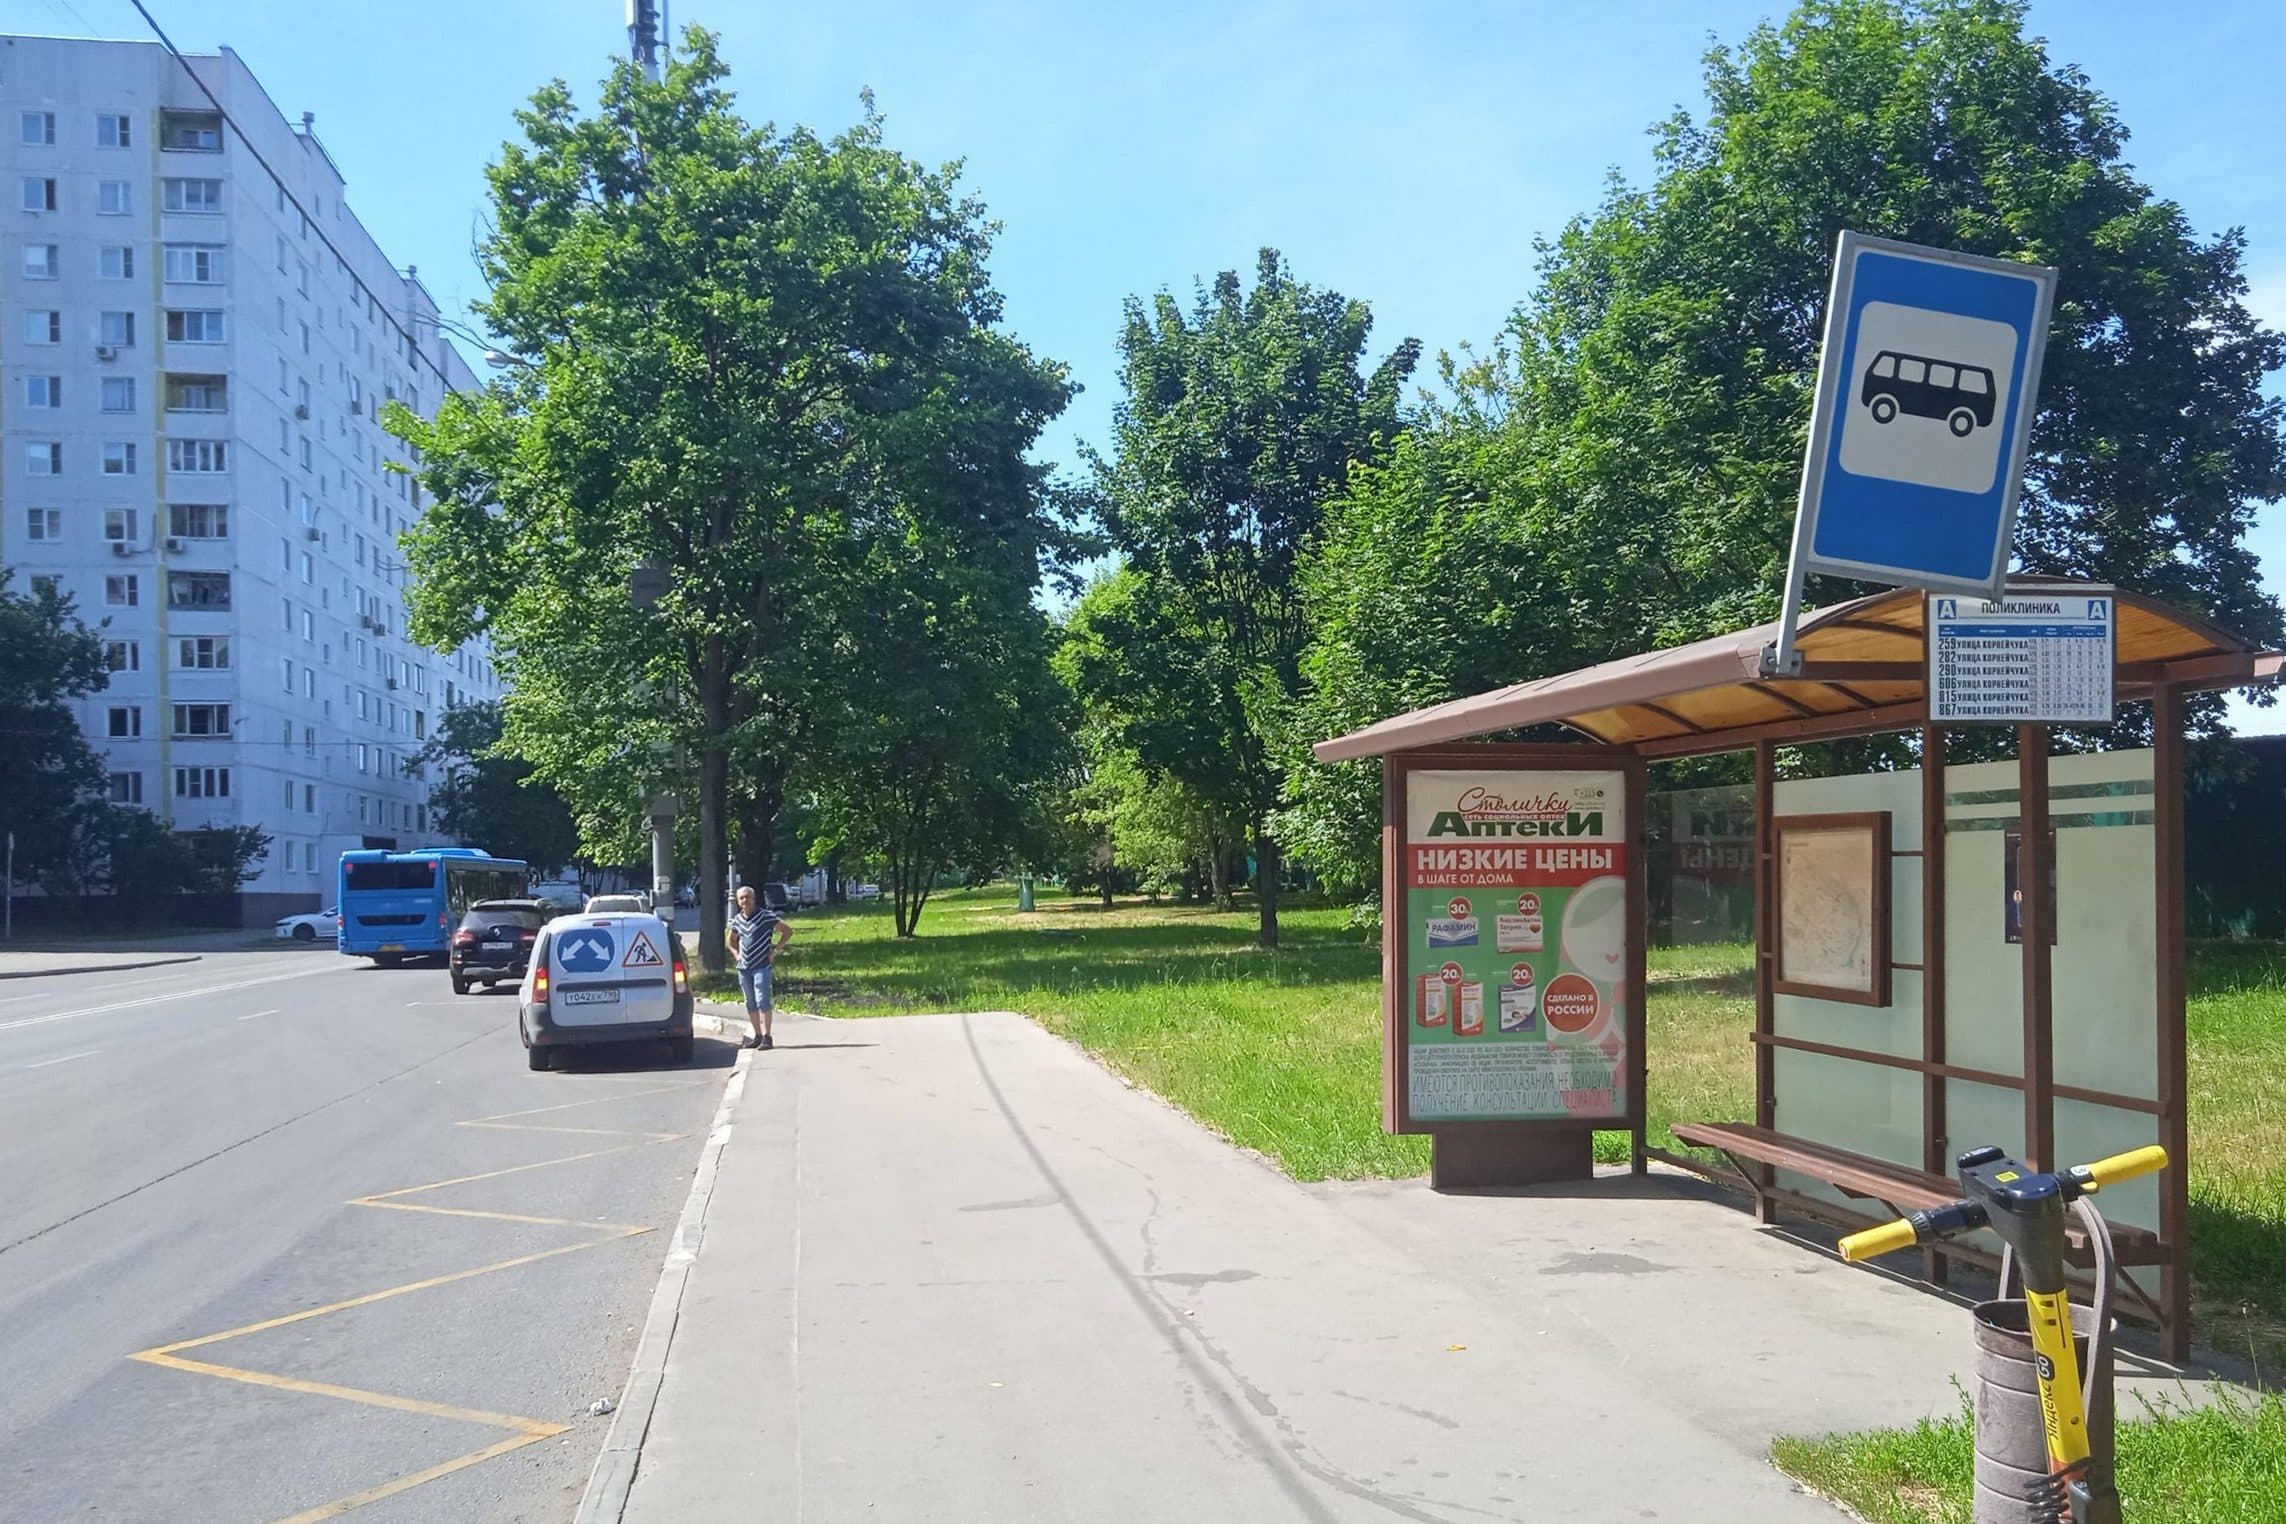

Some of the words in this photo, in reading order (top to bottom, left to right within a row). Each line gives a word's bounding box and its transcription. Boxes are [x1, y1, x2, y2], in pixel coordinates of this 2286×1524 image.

[1982, 602, 2061, 614] ПОЛИКЛИНИКА
[1938, 638, 1956, 649] 259
[1938, 651, 1956, 663] 282
[1938, 677, 1956, 689] 606
[1938, 690, 1956, 702] 815
[1417, 849, 1527, 870] НИЗКИЕ
[1535, 849, 1612, 872] ЦЕНЫ
[1418, 874, 1424, 884] В
[1427, 874, 1457, 884] ШАГЕ
[1461, 874, 1476, 884] ОТ
[1477, 874, 1513, 885] ДОМА
[1547, 1005, 1594, 1015] РОССИИ
[1413, 1073, 1458, 1092] ИМЕЮТСЯ
